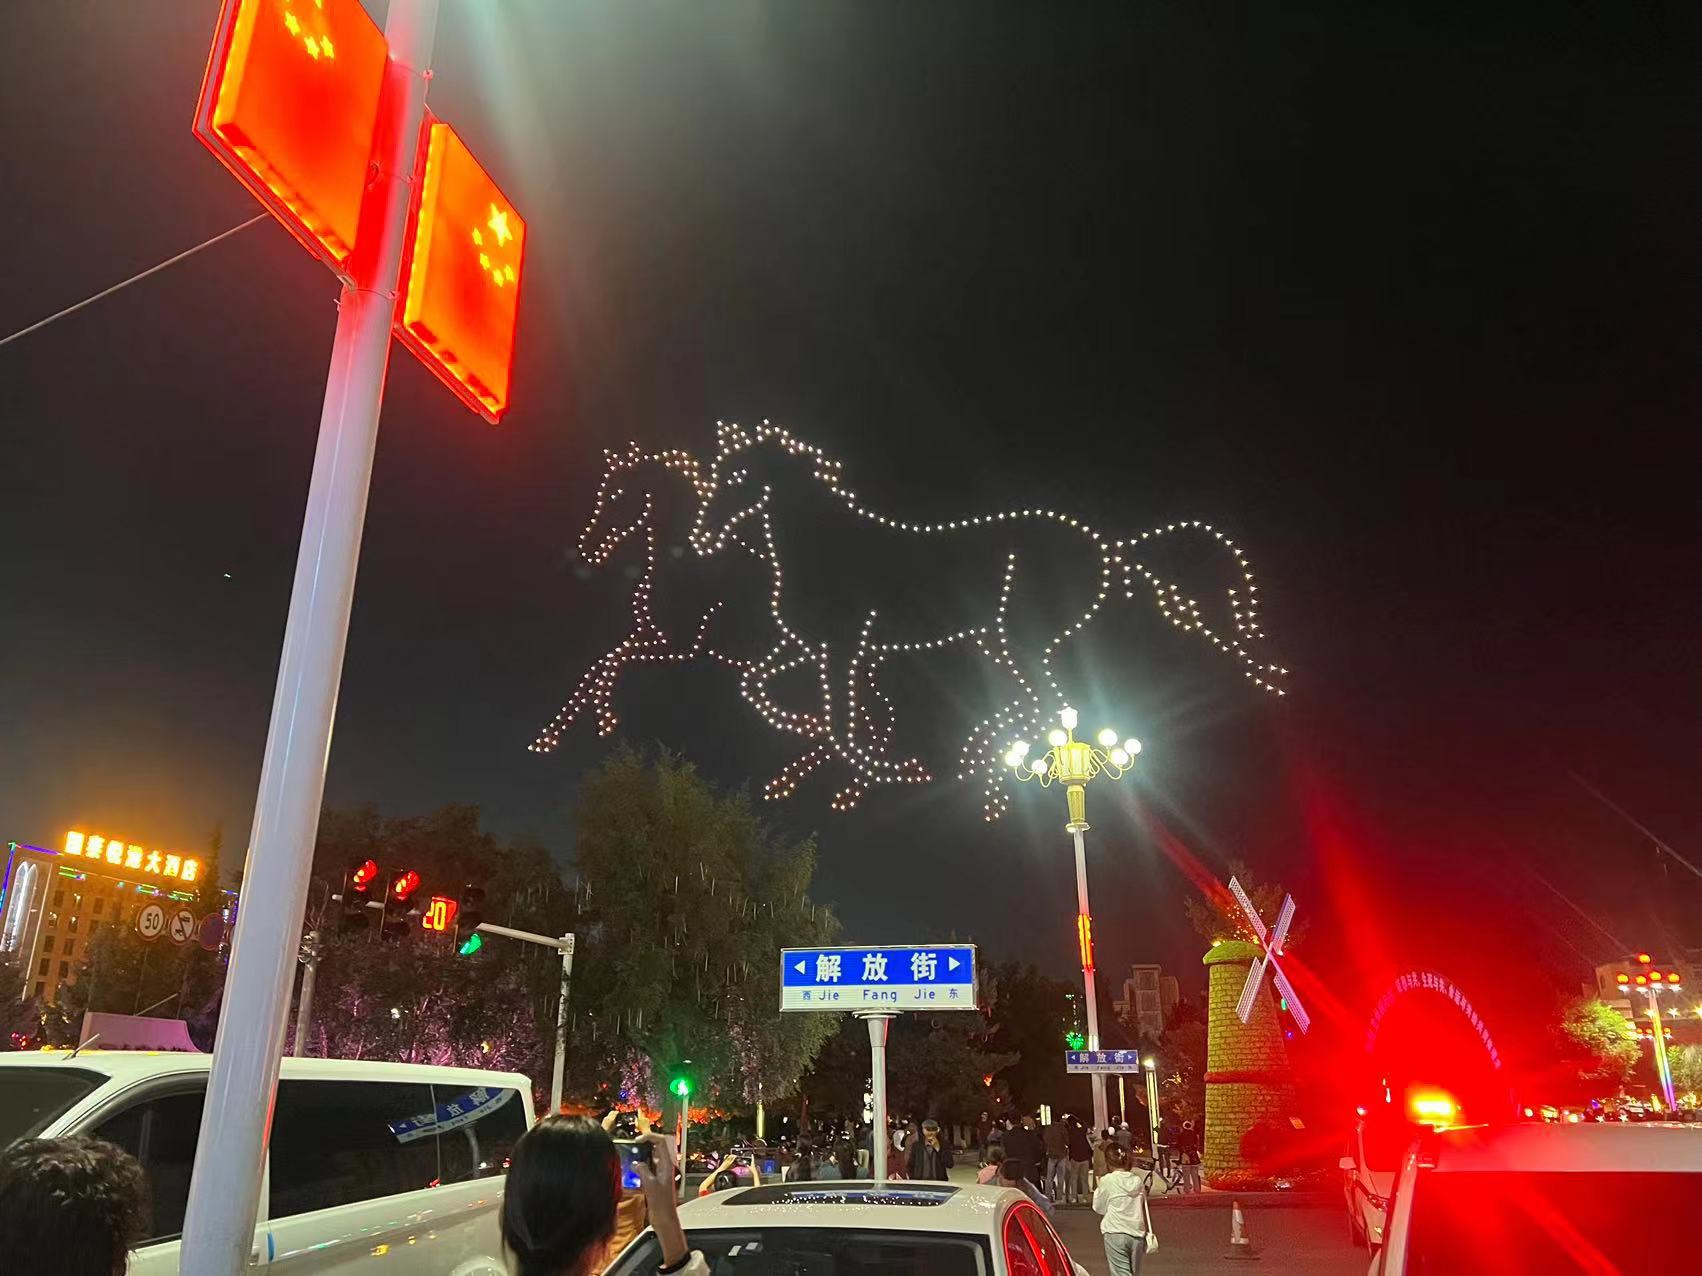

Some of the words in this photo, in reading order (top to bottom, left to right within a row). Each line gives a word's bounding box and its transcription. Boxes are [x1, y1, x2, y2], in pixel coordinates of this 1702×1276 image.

[145, 912, 160, 930] 50
[816, 952, 938, 982] 解放街
[819, 989, 839, 1000] Jie
[863, 989, 897, 1002] Fang
[914, 988, 936, 1000] Jie
[949, 988, 959, 999] 东
